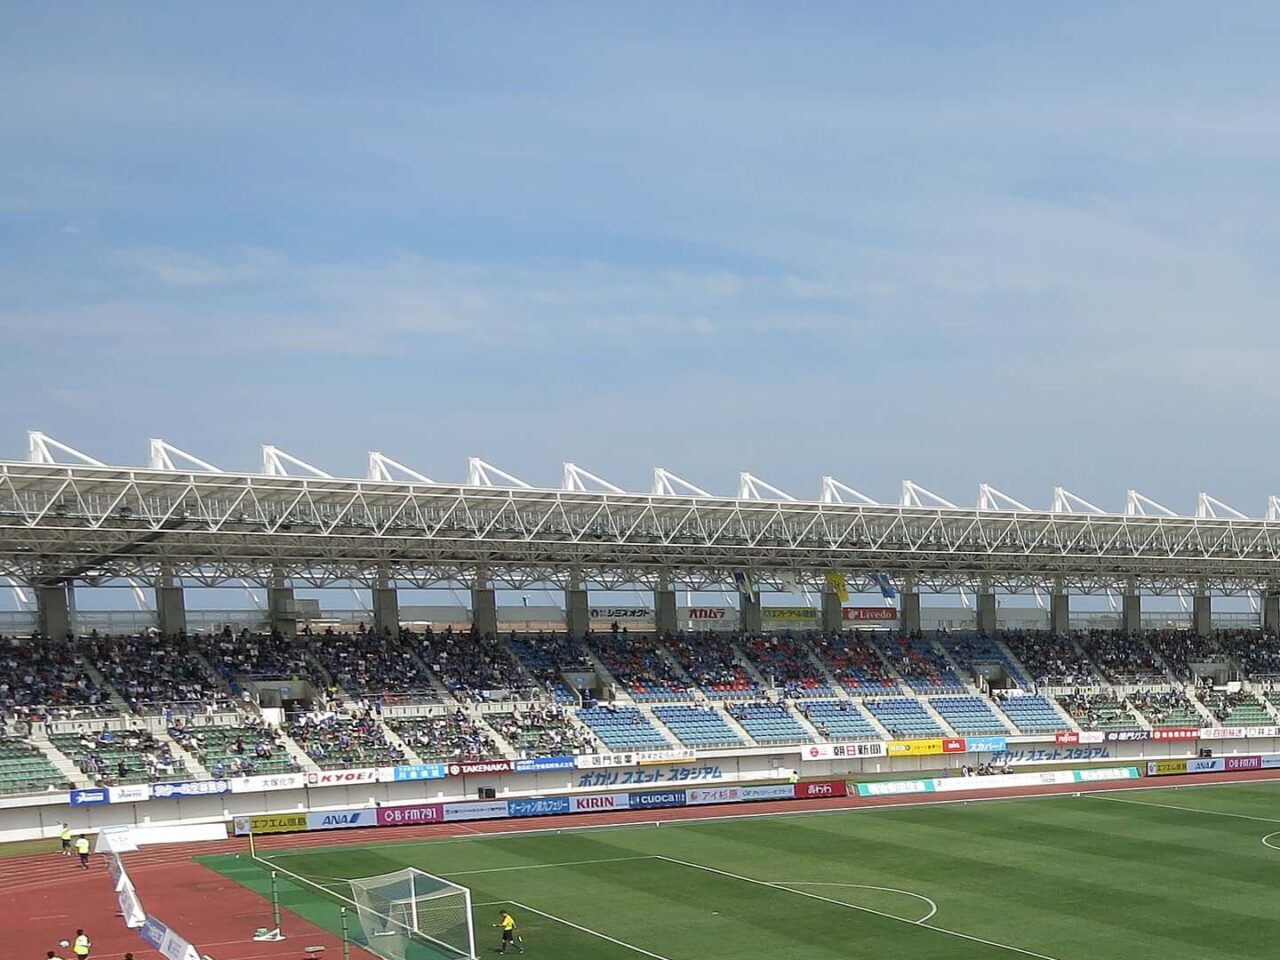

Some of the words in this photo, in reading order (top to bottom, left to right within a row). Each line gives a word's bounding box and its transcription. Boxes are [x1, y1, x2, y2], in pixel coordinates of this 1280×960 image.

[688, 608, 726, 619] オカムラ
[860, 609, 892, 619] Livedo
[462, 763, 509, 773] TAKENAKA
[321, 771, 373, 783] KYOEI
[808, 785, 832, 795] あわわ
[576, 797, 614, 810] KIRIN
[641, 795, 674, 804] cuoca
[322, 814, 353, 825] ANA
